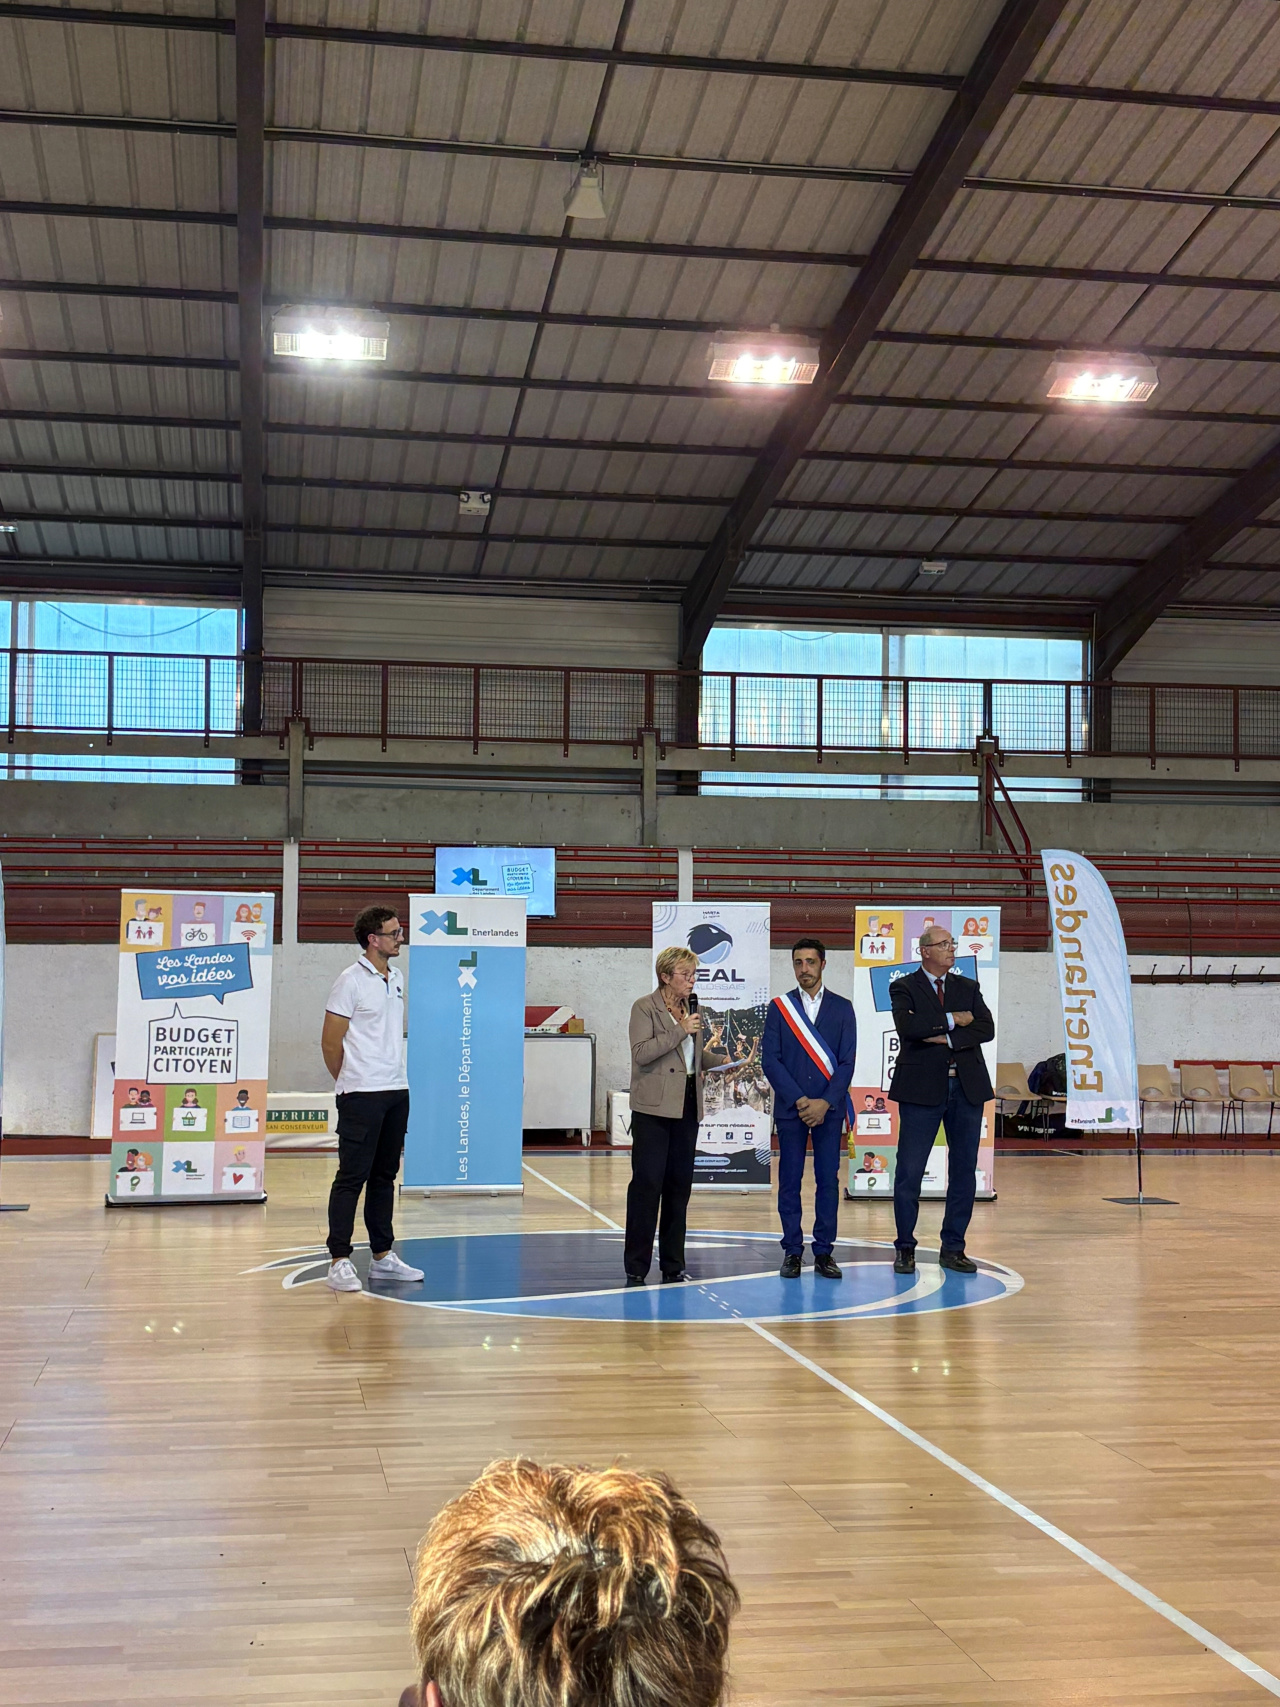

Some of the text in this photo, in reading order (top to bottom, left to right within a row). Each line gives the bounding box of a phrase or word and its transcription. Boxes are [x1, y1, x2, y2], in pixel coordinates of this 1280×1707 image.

[472, 929, 519, 937] Enerlandes
[156, 953, 236, 971] Les Landes
[157, 967, 236, 986] vos idées
[695, 968, 745, 982] EAL
[154, 1046, 232, 1057] PARTICIPATIF
[153, 1058, 232, 1074] CITOYEN
[456, 992, 473, 1181] Les Landes, le Département
[269, 1110, 326, 1121] PERIER
